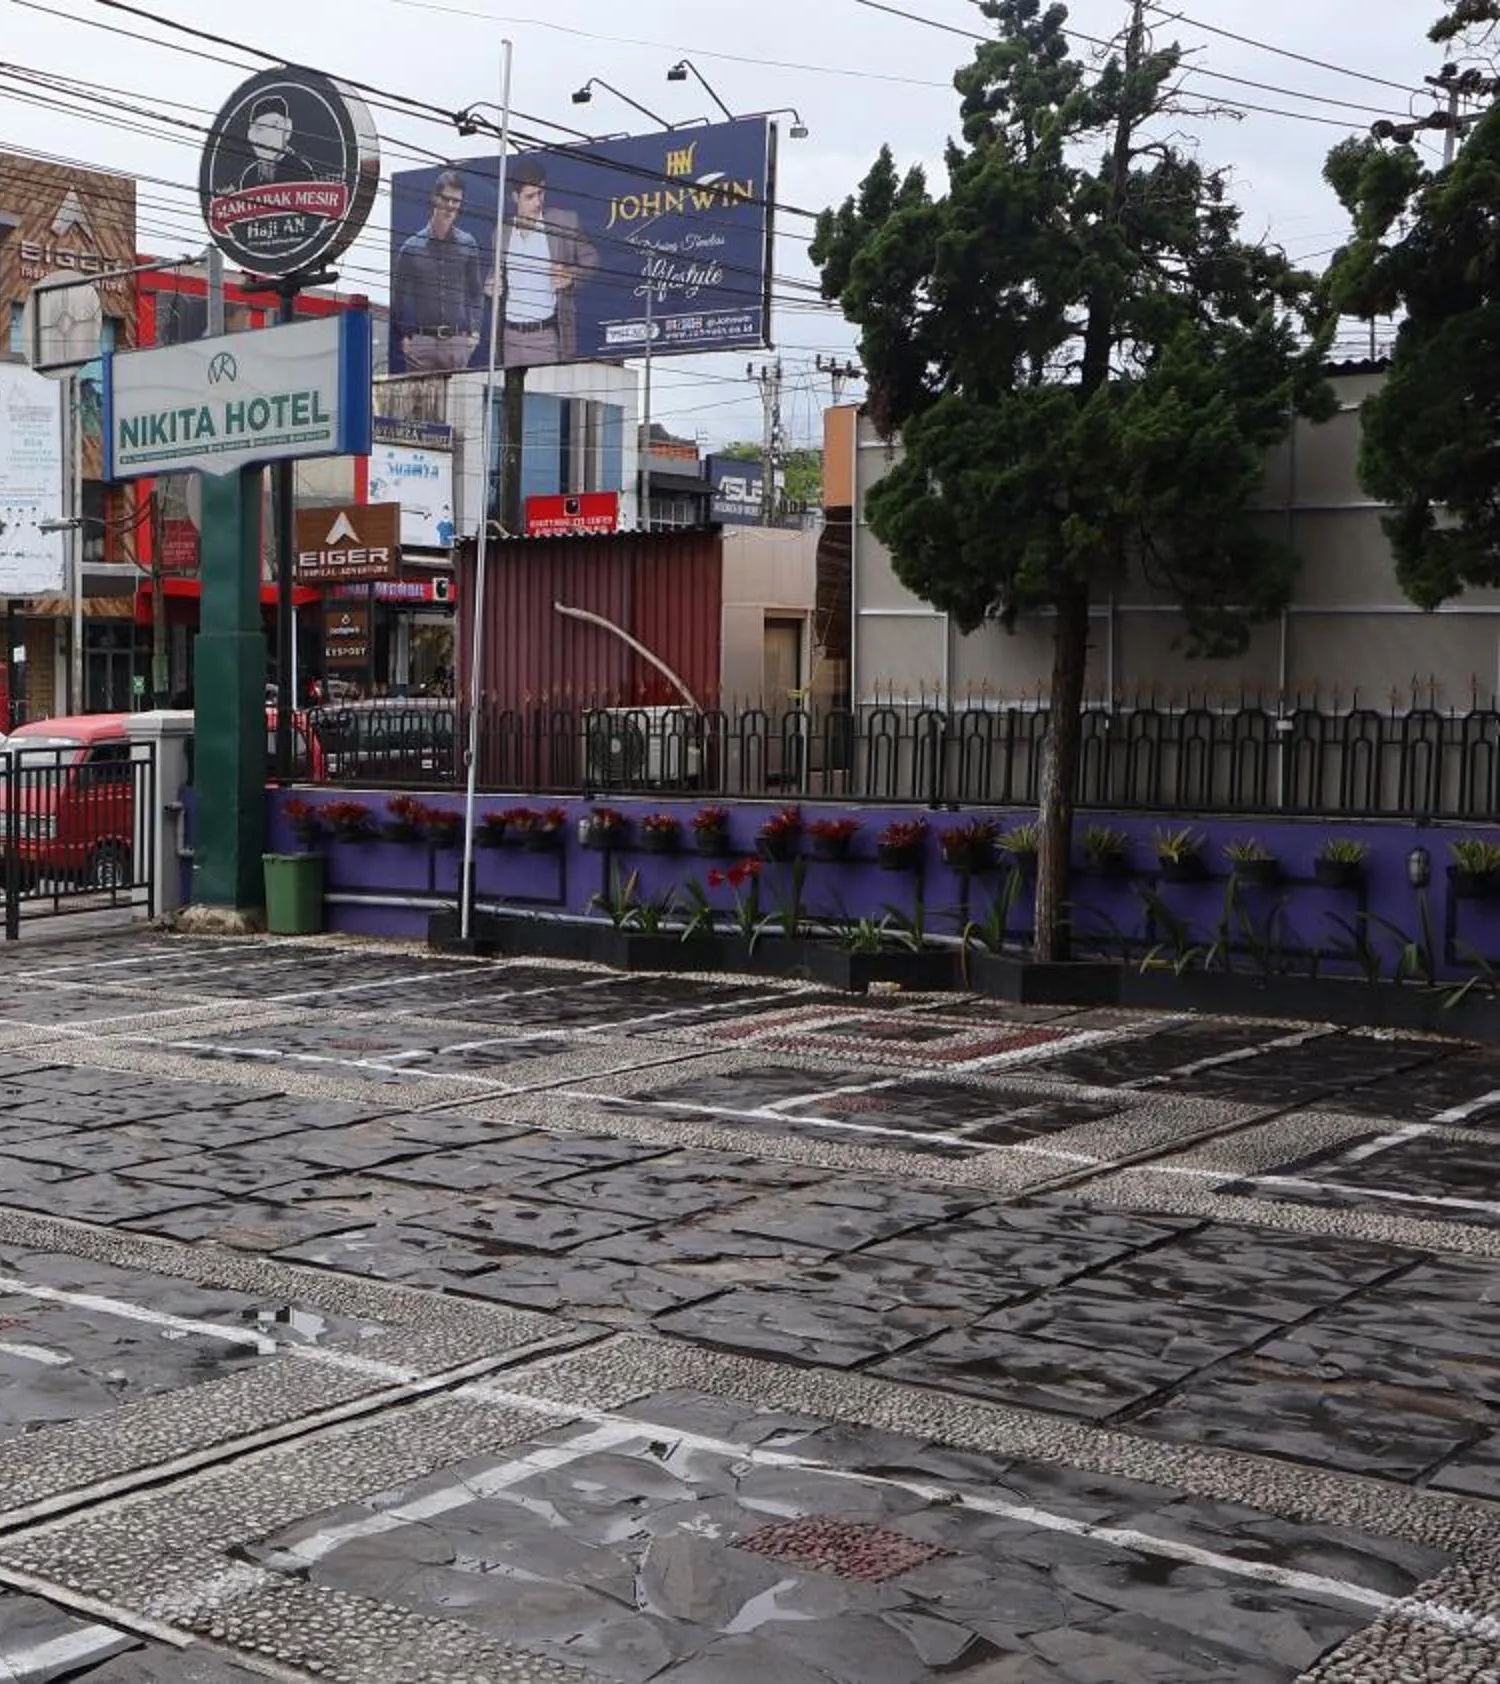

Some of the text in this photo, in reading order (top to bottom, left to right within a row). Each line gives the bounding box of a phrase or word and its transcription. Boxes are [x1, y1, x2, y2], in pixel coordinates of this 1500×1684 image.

[215, 191, 340, 219] MARTABAK MESIR
[247, 217, 307, 239] Haji AN
[20, 239, 130, 275] EIGER
[119, 405, 217, 449] NIKITA
[225, 390, 330, 435] HOTEL
[299, 547, 389, 567] EIGER
